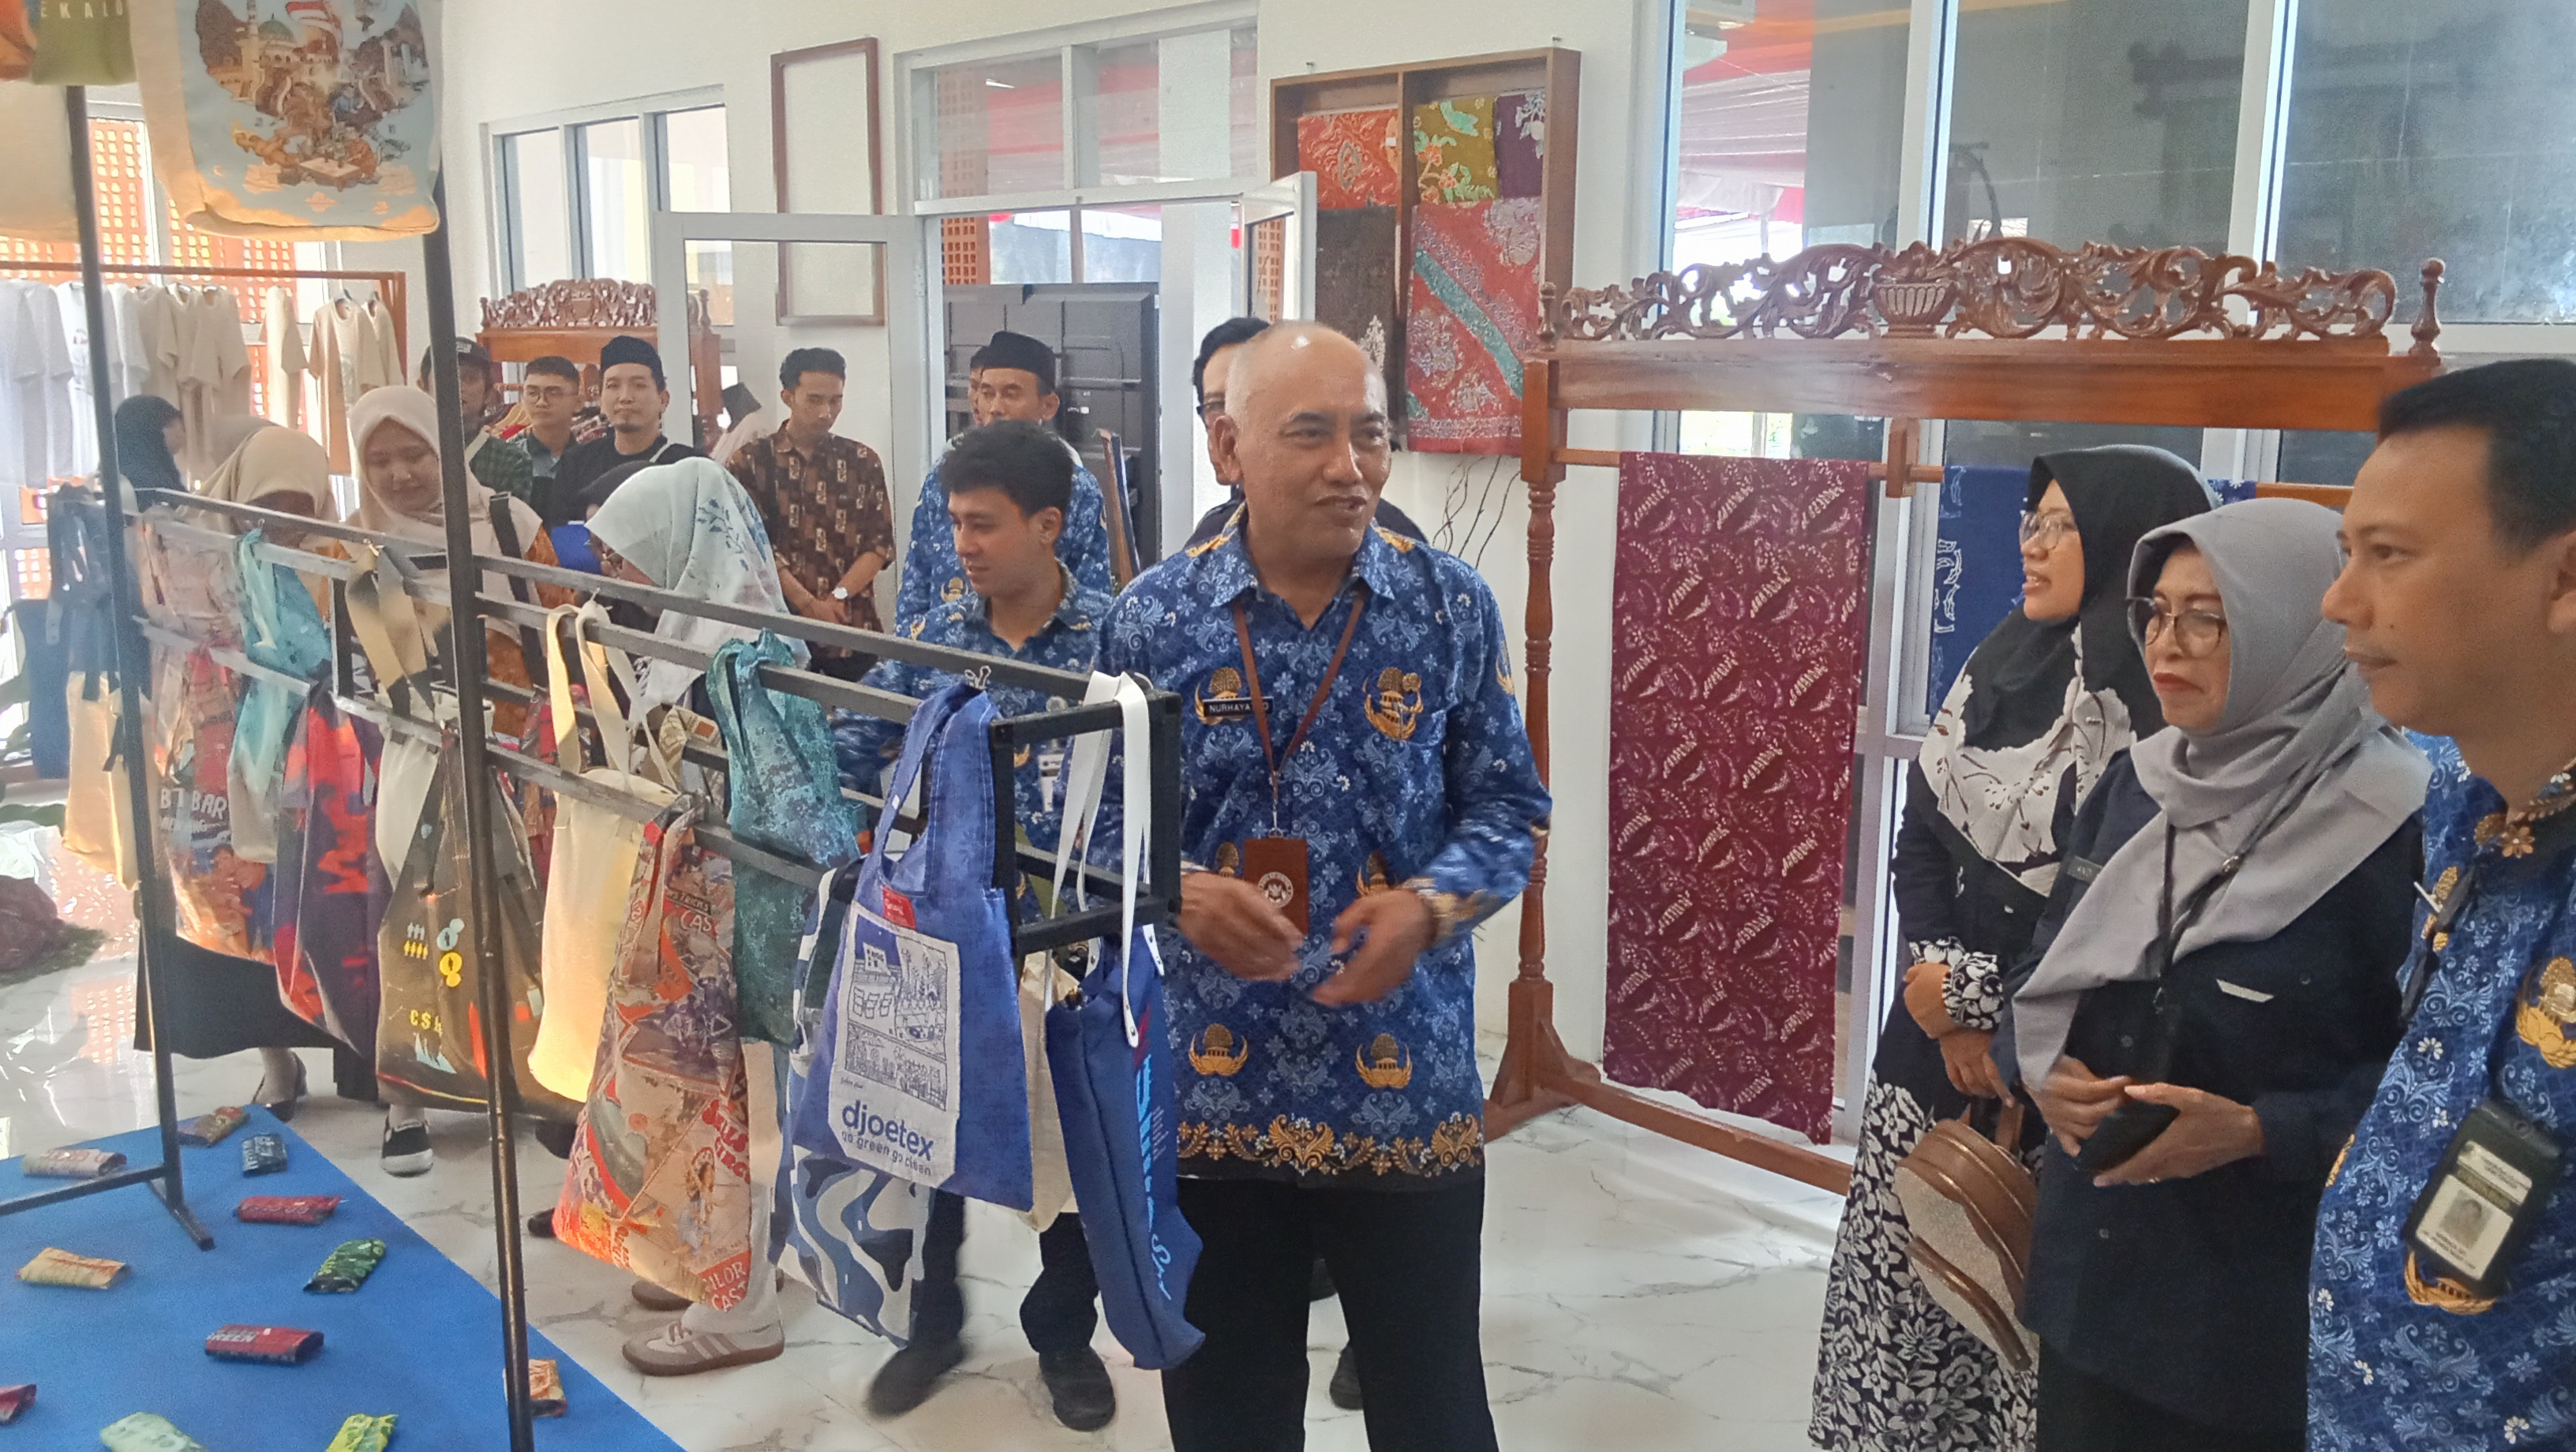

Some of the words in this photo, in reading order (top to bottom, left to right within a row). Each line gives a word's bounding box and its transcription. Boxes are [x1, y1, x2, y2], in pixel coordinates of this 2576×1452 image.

[842, 1099, 934, 1162] djoetex
[857, 1137, 889, 1156] green
[892, 1150, 903, 1163] go
